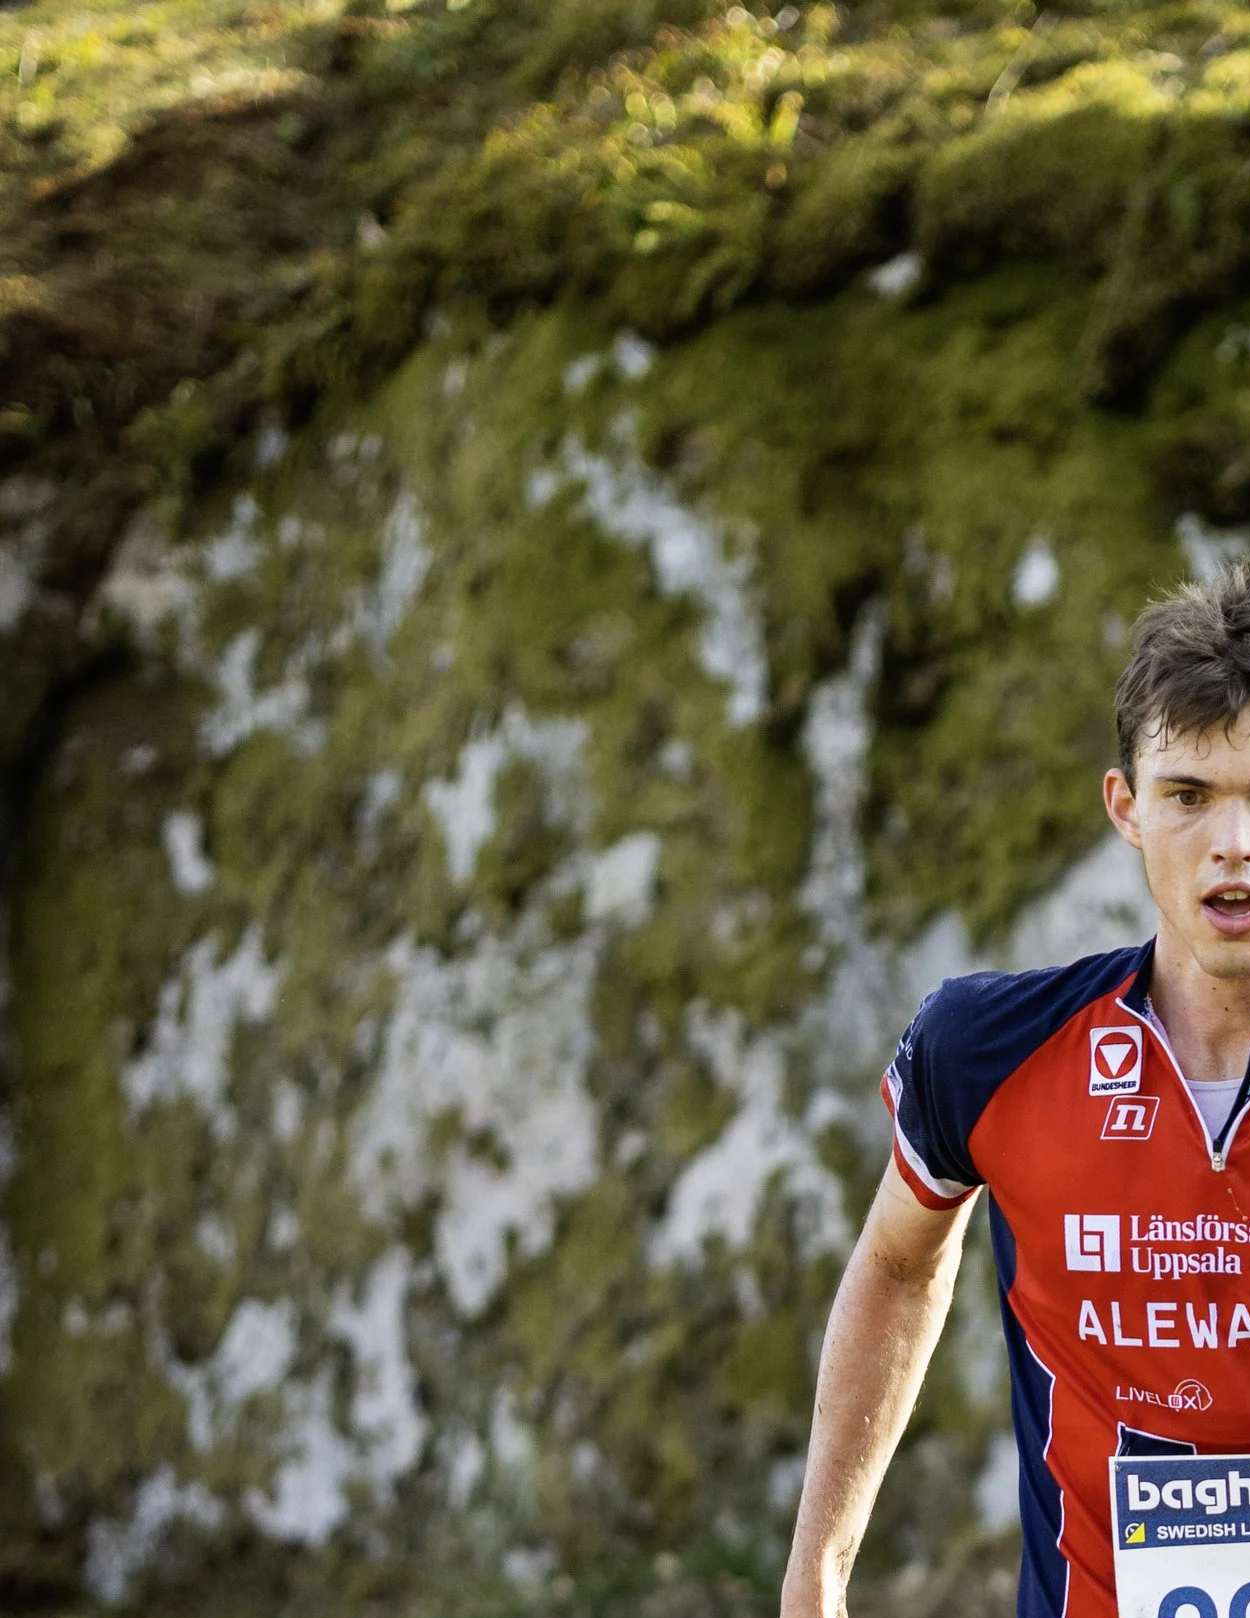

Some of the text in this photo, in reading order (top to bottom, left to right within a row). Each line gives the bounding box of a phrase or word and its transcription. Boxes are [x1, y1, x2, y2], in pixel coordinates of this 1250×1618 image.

[1091, 1080, 1137, 1092] BUNDESHEER
[1131, 1247, 1242, 1280] Uppsala
[1157, 1523, 1236, 1540] SWEDISH
